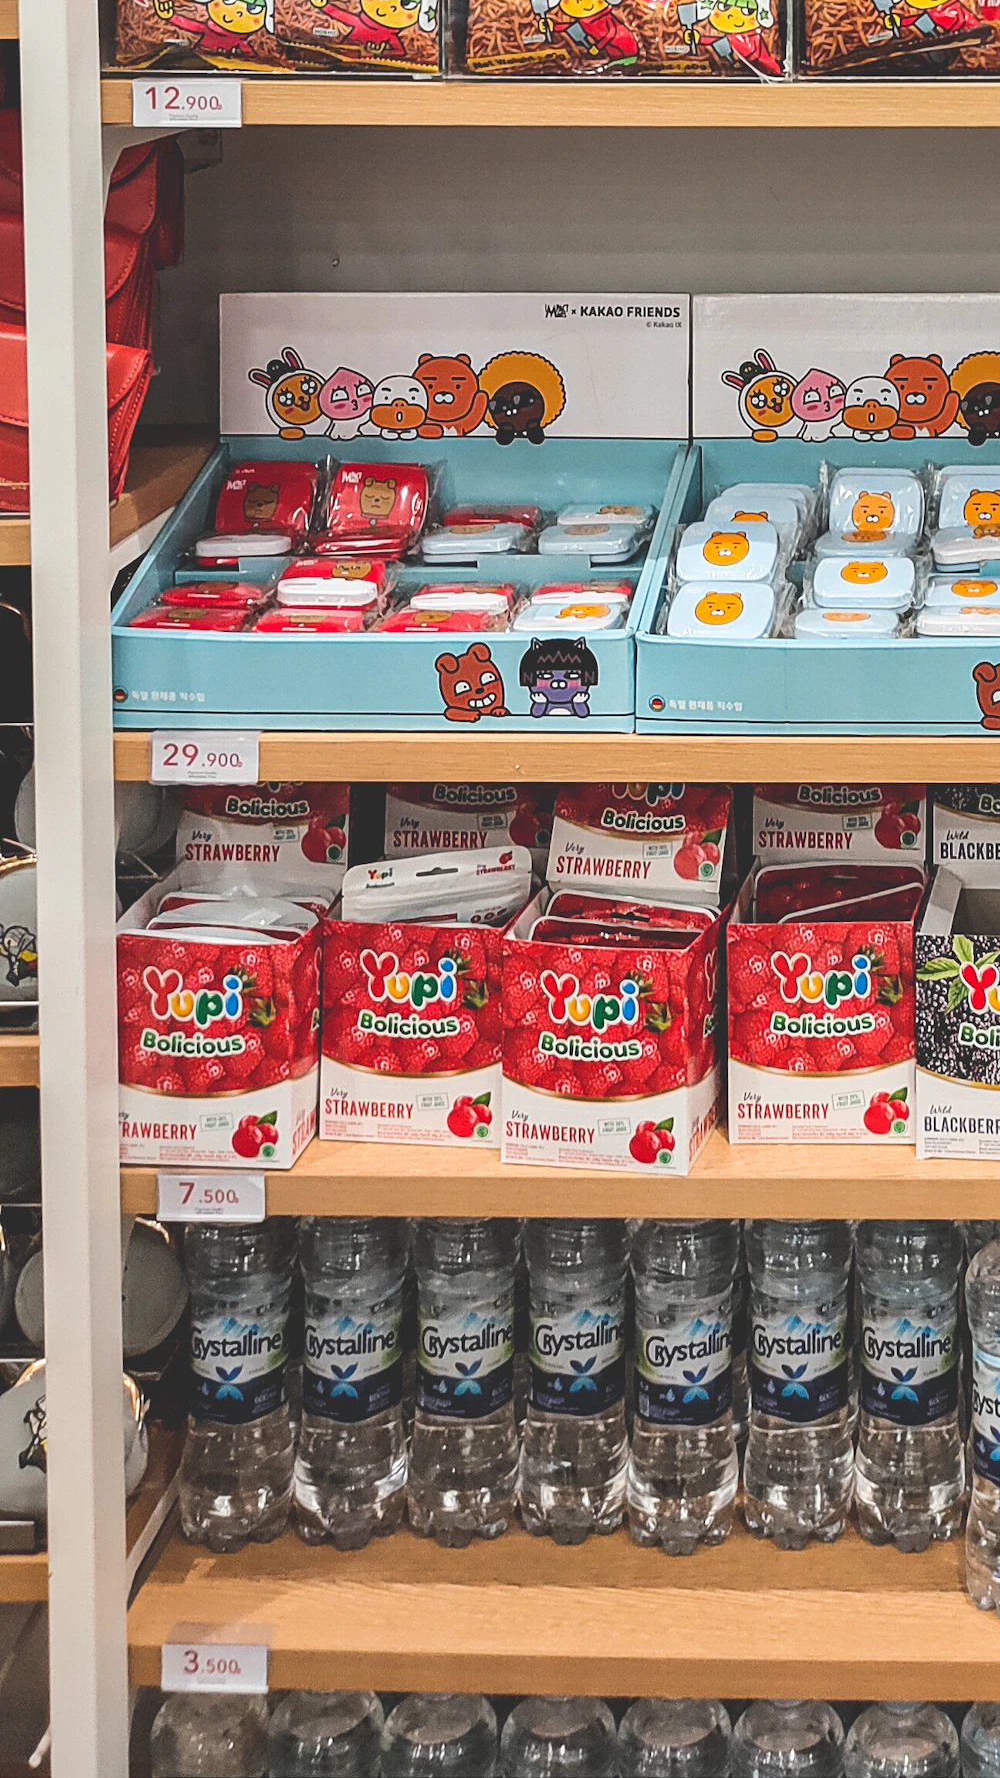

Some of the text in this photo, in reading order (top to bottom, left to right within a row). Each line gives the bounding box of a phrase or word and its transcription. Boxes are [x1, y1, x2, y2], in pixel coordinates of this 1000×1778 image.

[145, 83, 220, 110] 12.900
[580, 305, 682, 319] KAKAO FRIENDS
[162, 742, 238, 769] 29.900
[757, 830, 854, 850] STRAWBERRY
[945, 828, 969, 842] Wild
[184, 843, 281, 863] STRAWBERRY
[555, 854, 652, 879] STRAWBERRY
[360, 949, 458, 1010] Yupi
[770, 951, 869, 1009] Yupi
[143, 965, 244, 1029] Yupi
[541, 969, 640, 1030] Yupi
[357, 1010, 461, 1039] Bolicious
[769, 1011, 875, 1038] Bolicious
[140, 1028, 247, 1058] Bolicious
[538, 1030, 643, 1061] Bolicious
[325, 1098, 414, 1120] STRAWBERRY
[737, 1102, 830, 1120] STRAWBERRY
[504, 1121, 595, 1145] STRAWBERRY
[178, 1183, 236, 1206] 7.500
[183, 1648, 237, 1673] 3.500
